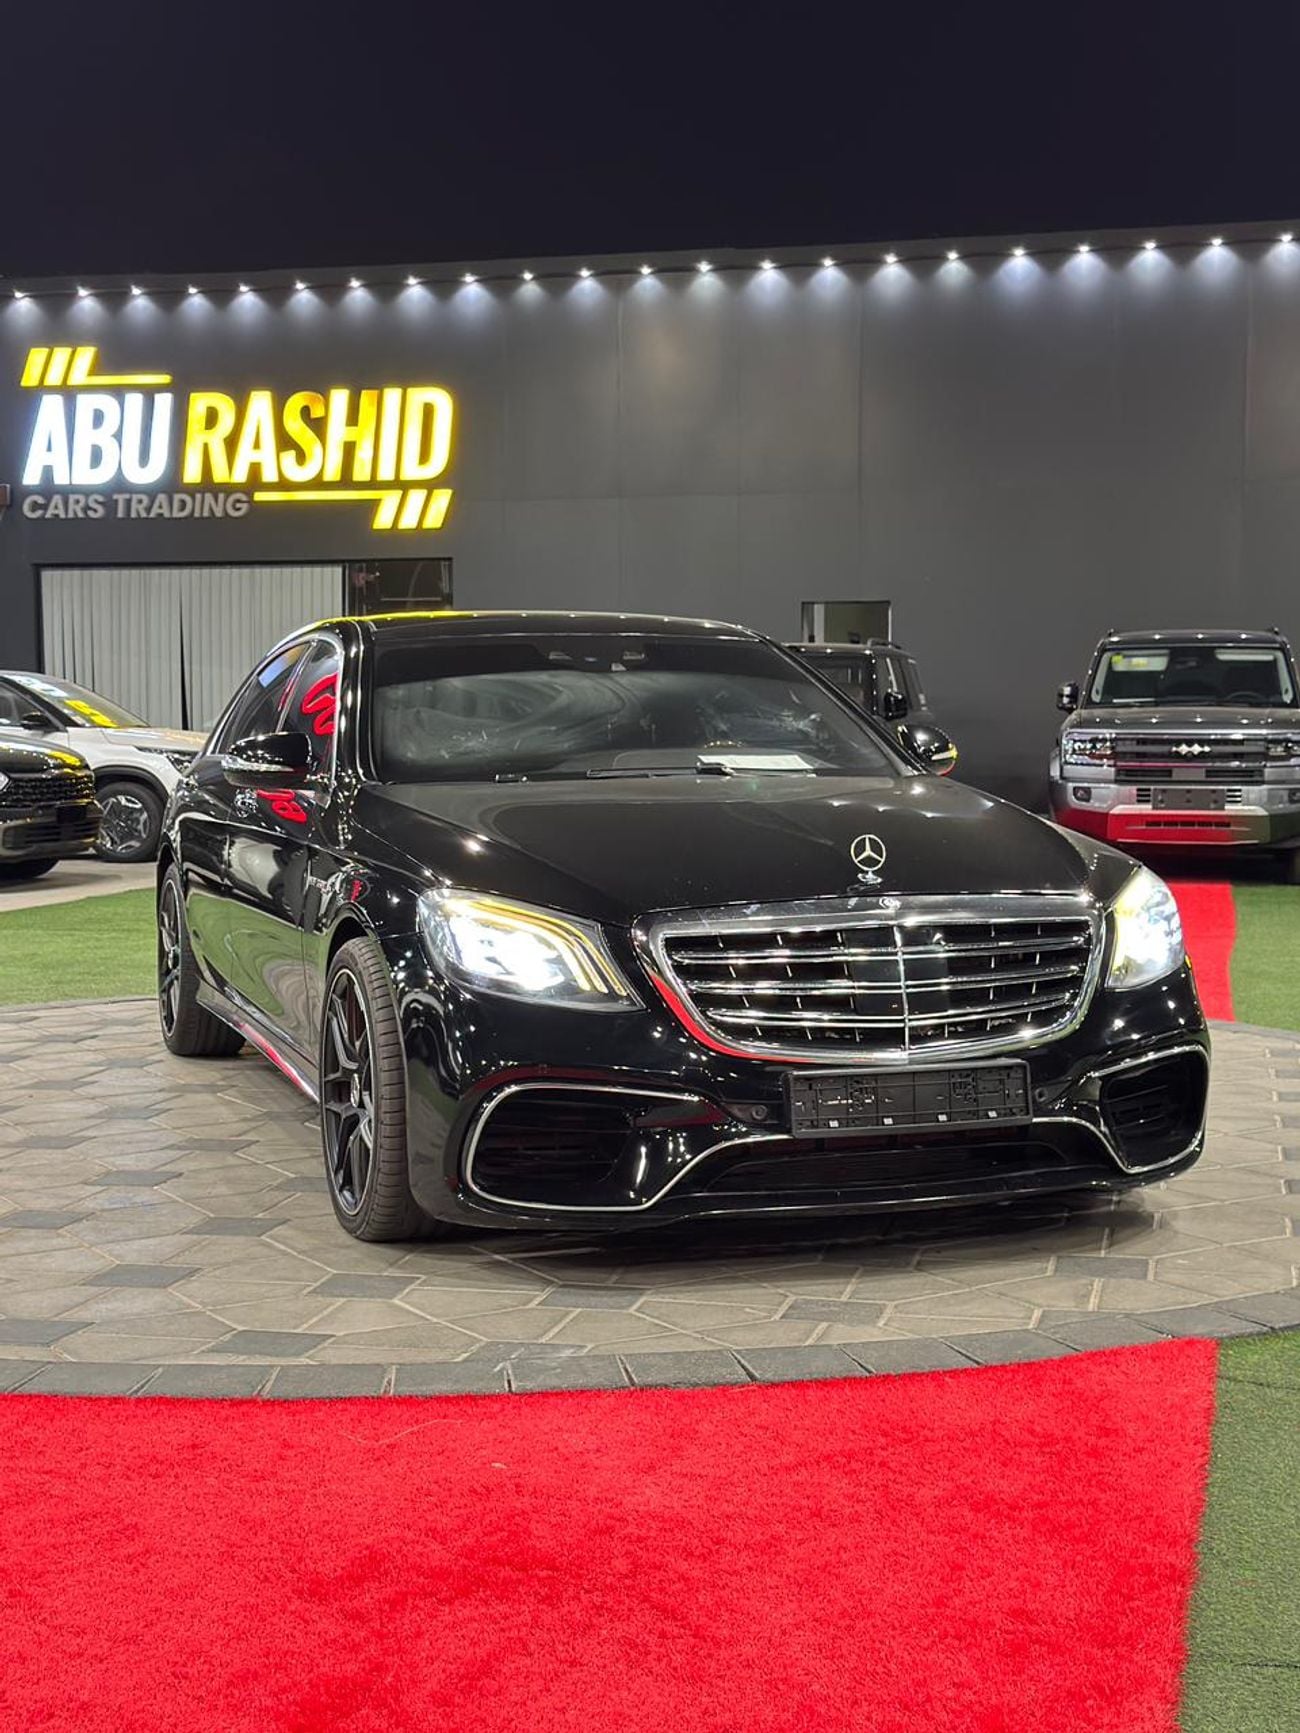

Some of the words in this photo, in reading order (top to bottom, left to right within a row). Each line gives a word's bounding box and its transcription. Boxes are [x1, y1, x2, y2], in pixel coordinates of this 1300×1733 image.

[22, 393, 173, 485] ABU
[182, 386, 454, 484] RASHID
[22, 494, 105, 519] CARS
[113, 492, 250, 519] TRADING
